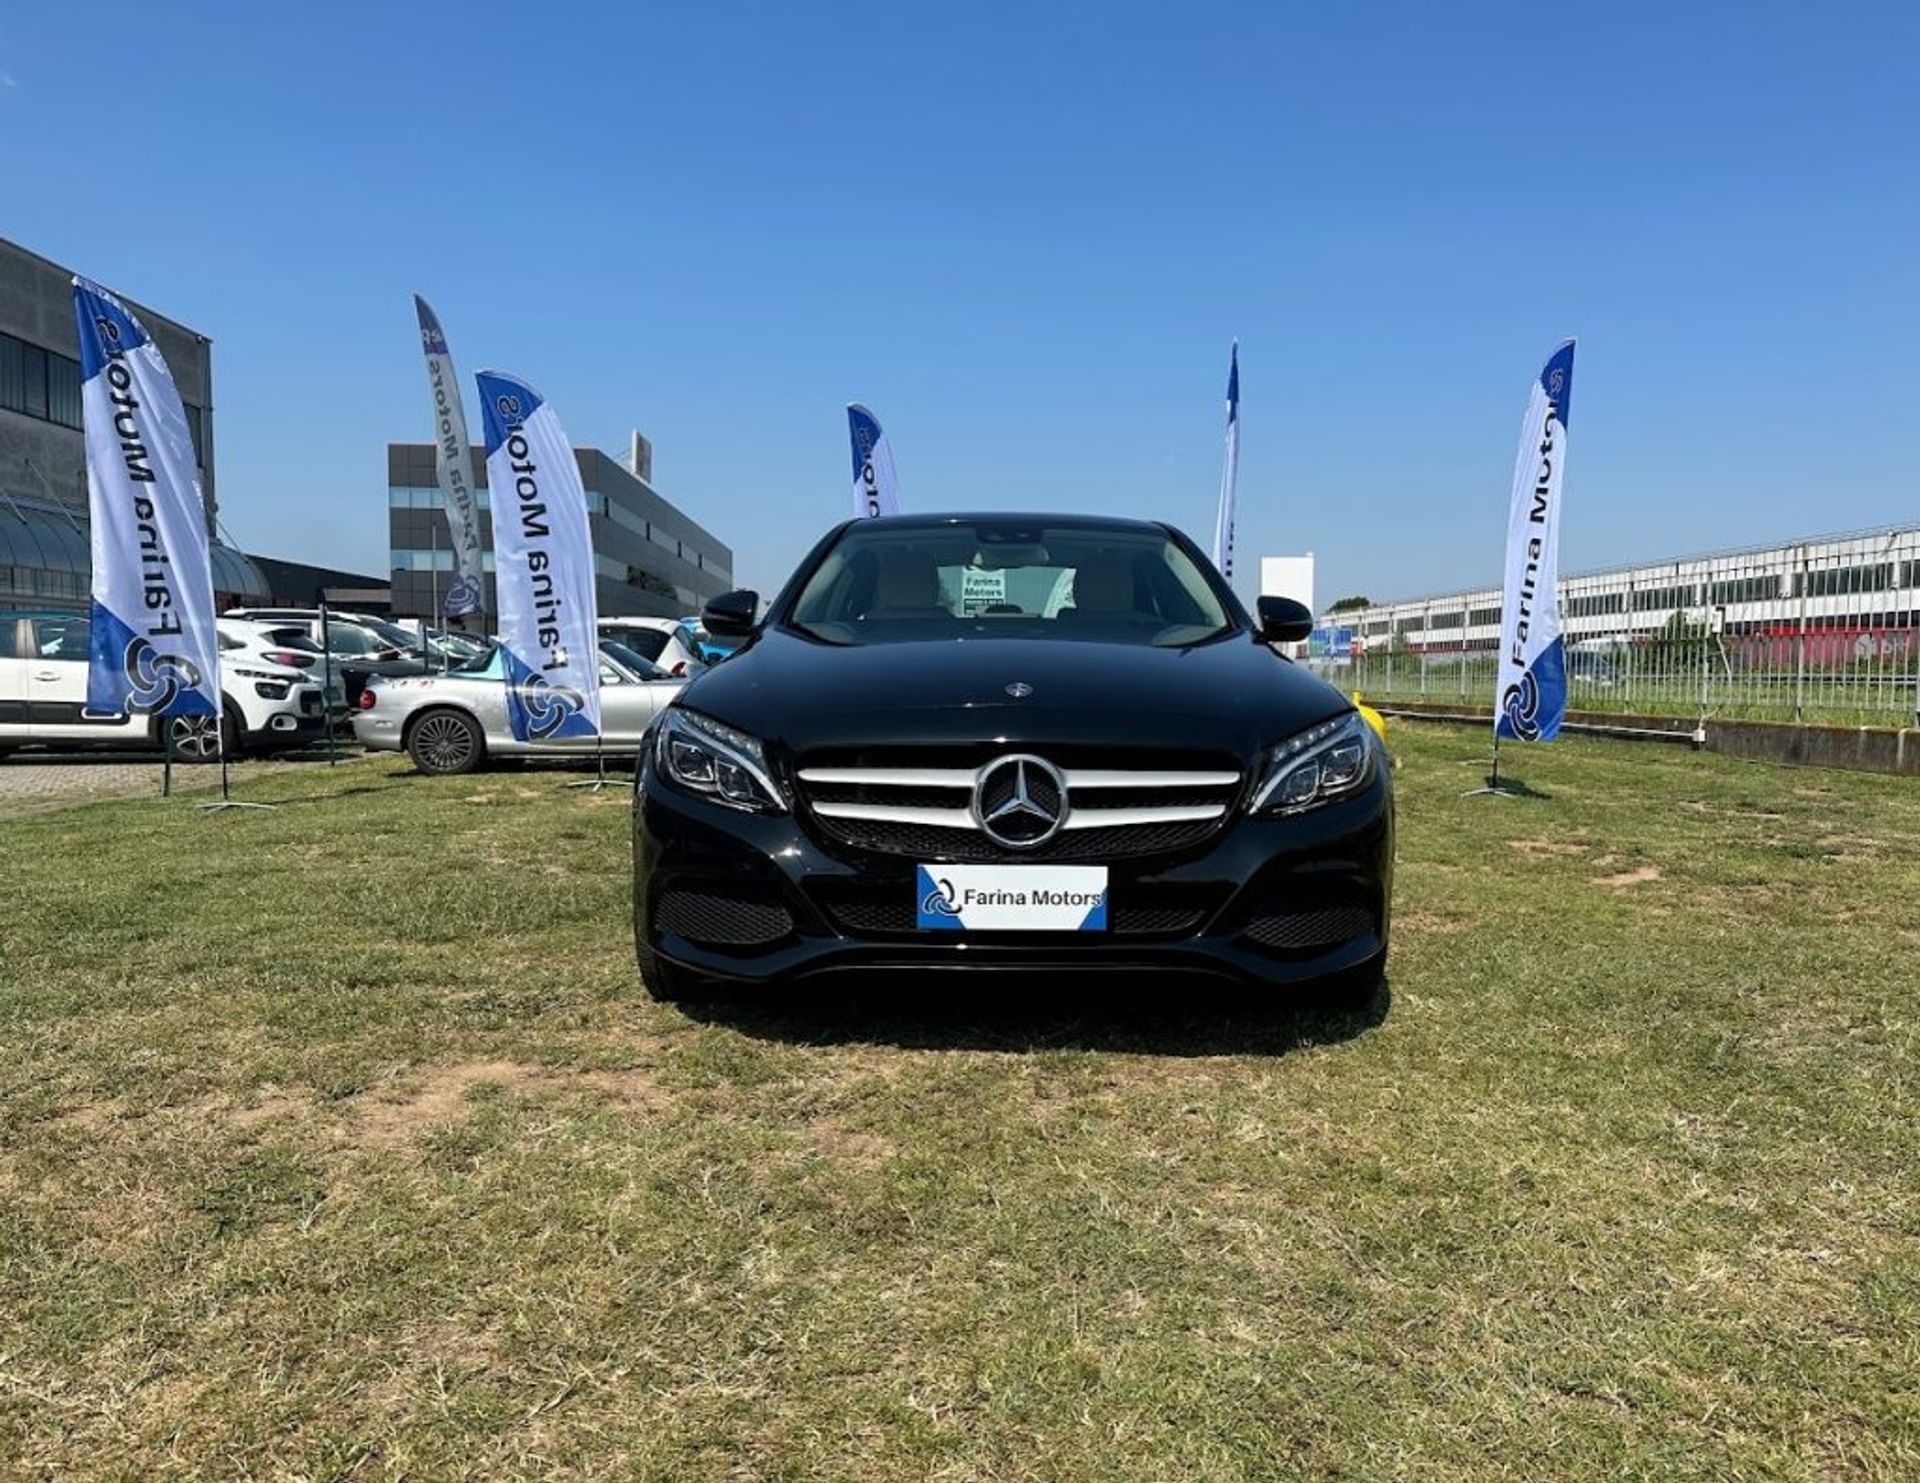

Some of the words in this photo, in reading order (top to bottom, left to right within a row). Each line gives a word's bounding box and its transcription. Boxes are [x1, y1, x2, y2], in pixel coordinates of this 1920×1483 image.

[1511, 537, 1541, 668] Farina
[963, 888, 1027, 906] Farina
[1031, 889, 1103, 908] Motors
